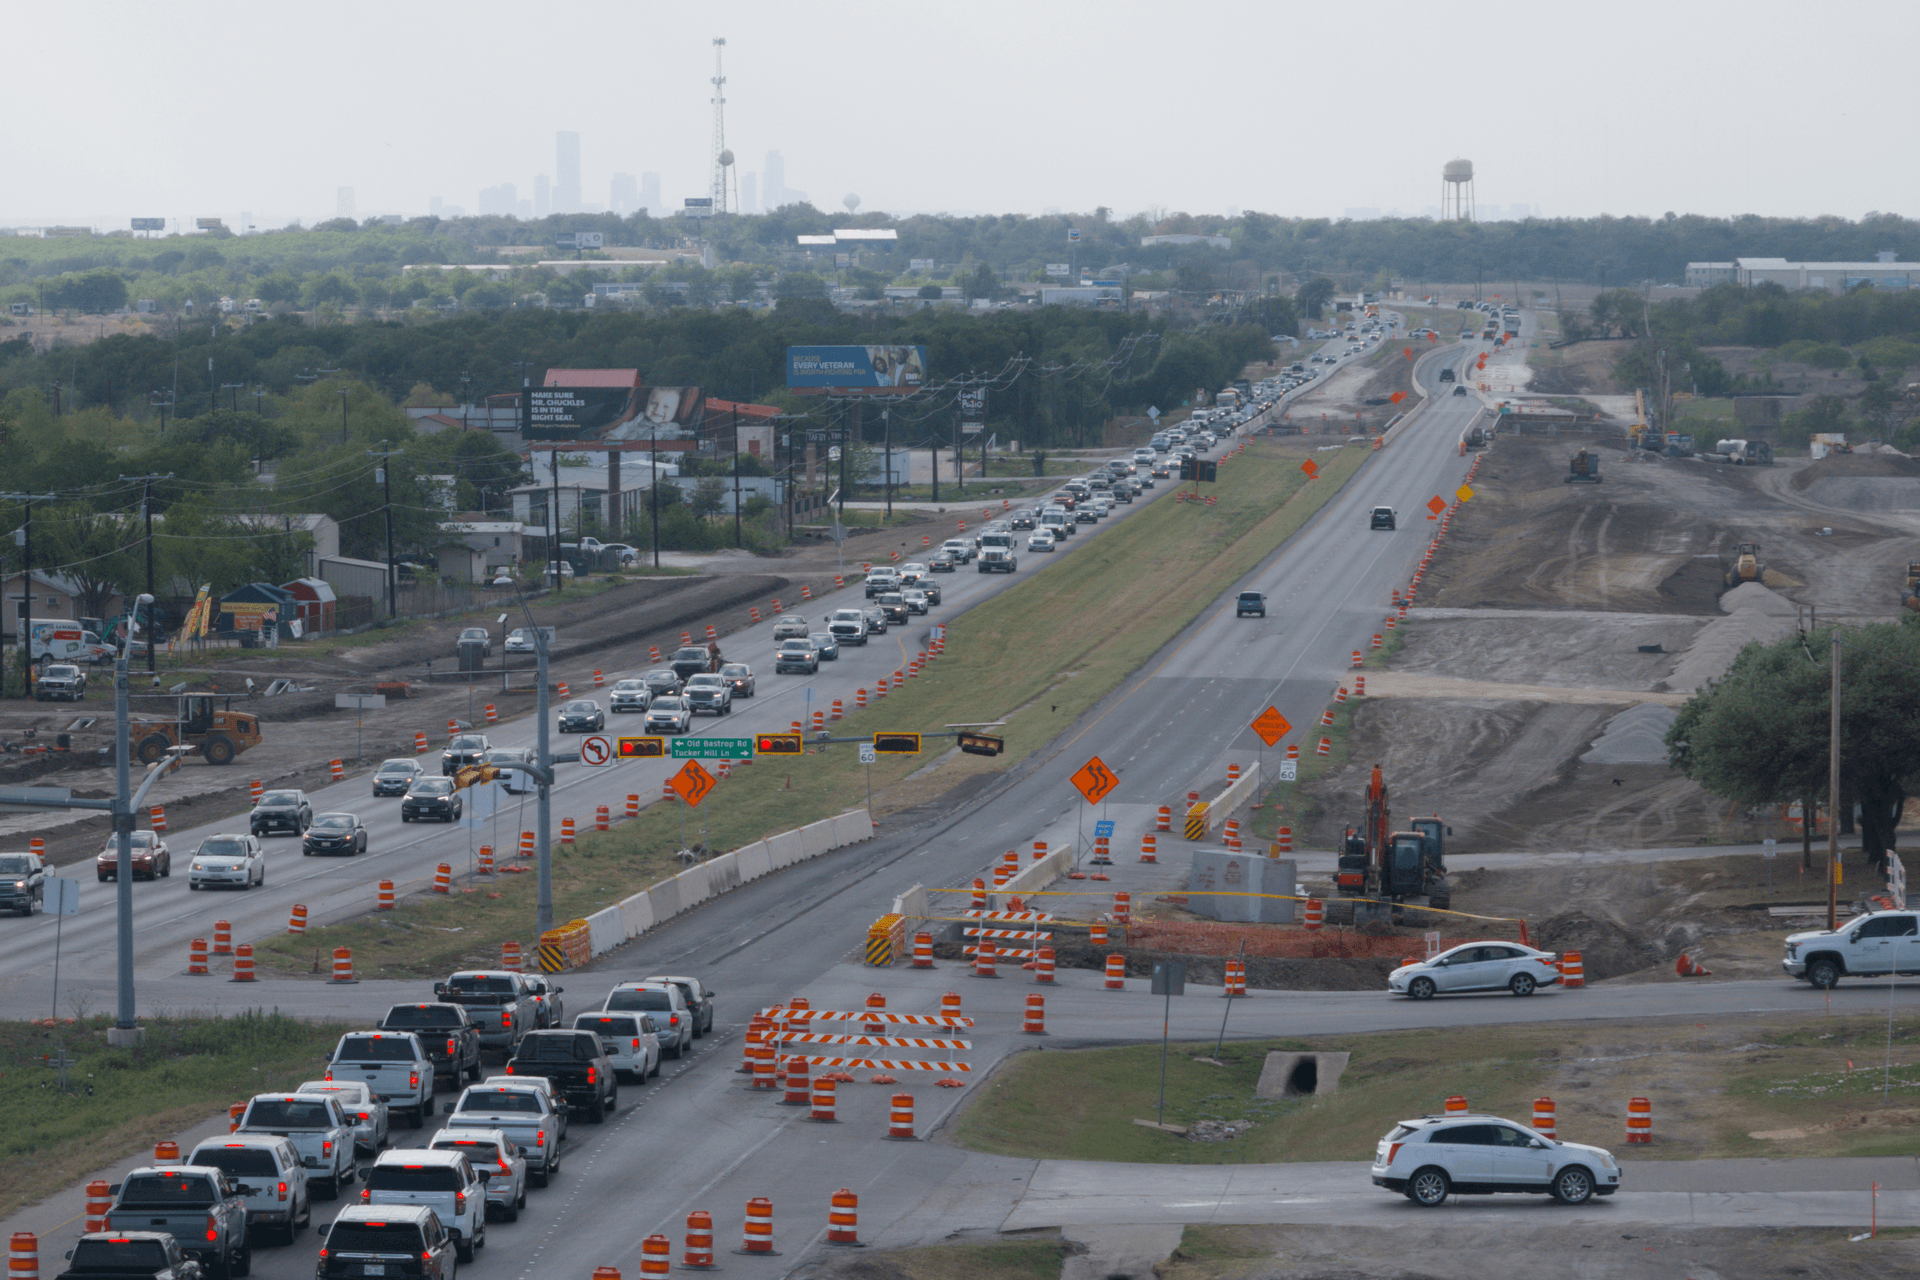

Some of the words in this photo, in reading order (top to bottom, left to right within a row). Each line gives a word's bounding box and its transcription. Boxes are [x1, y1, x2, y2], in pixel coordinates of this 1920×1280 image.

[703, 740, 734, 748] Bastrop
[861, 753, 874, 762] 60
[1281, 771, 1295, 779] 60
